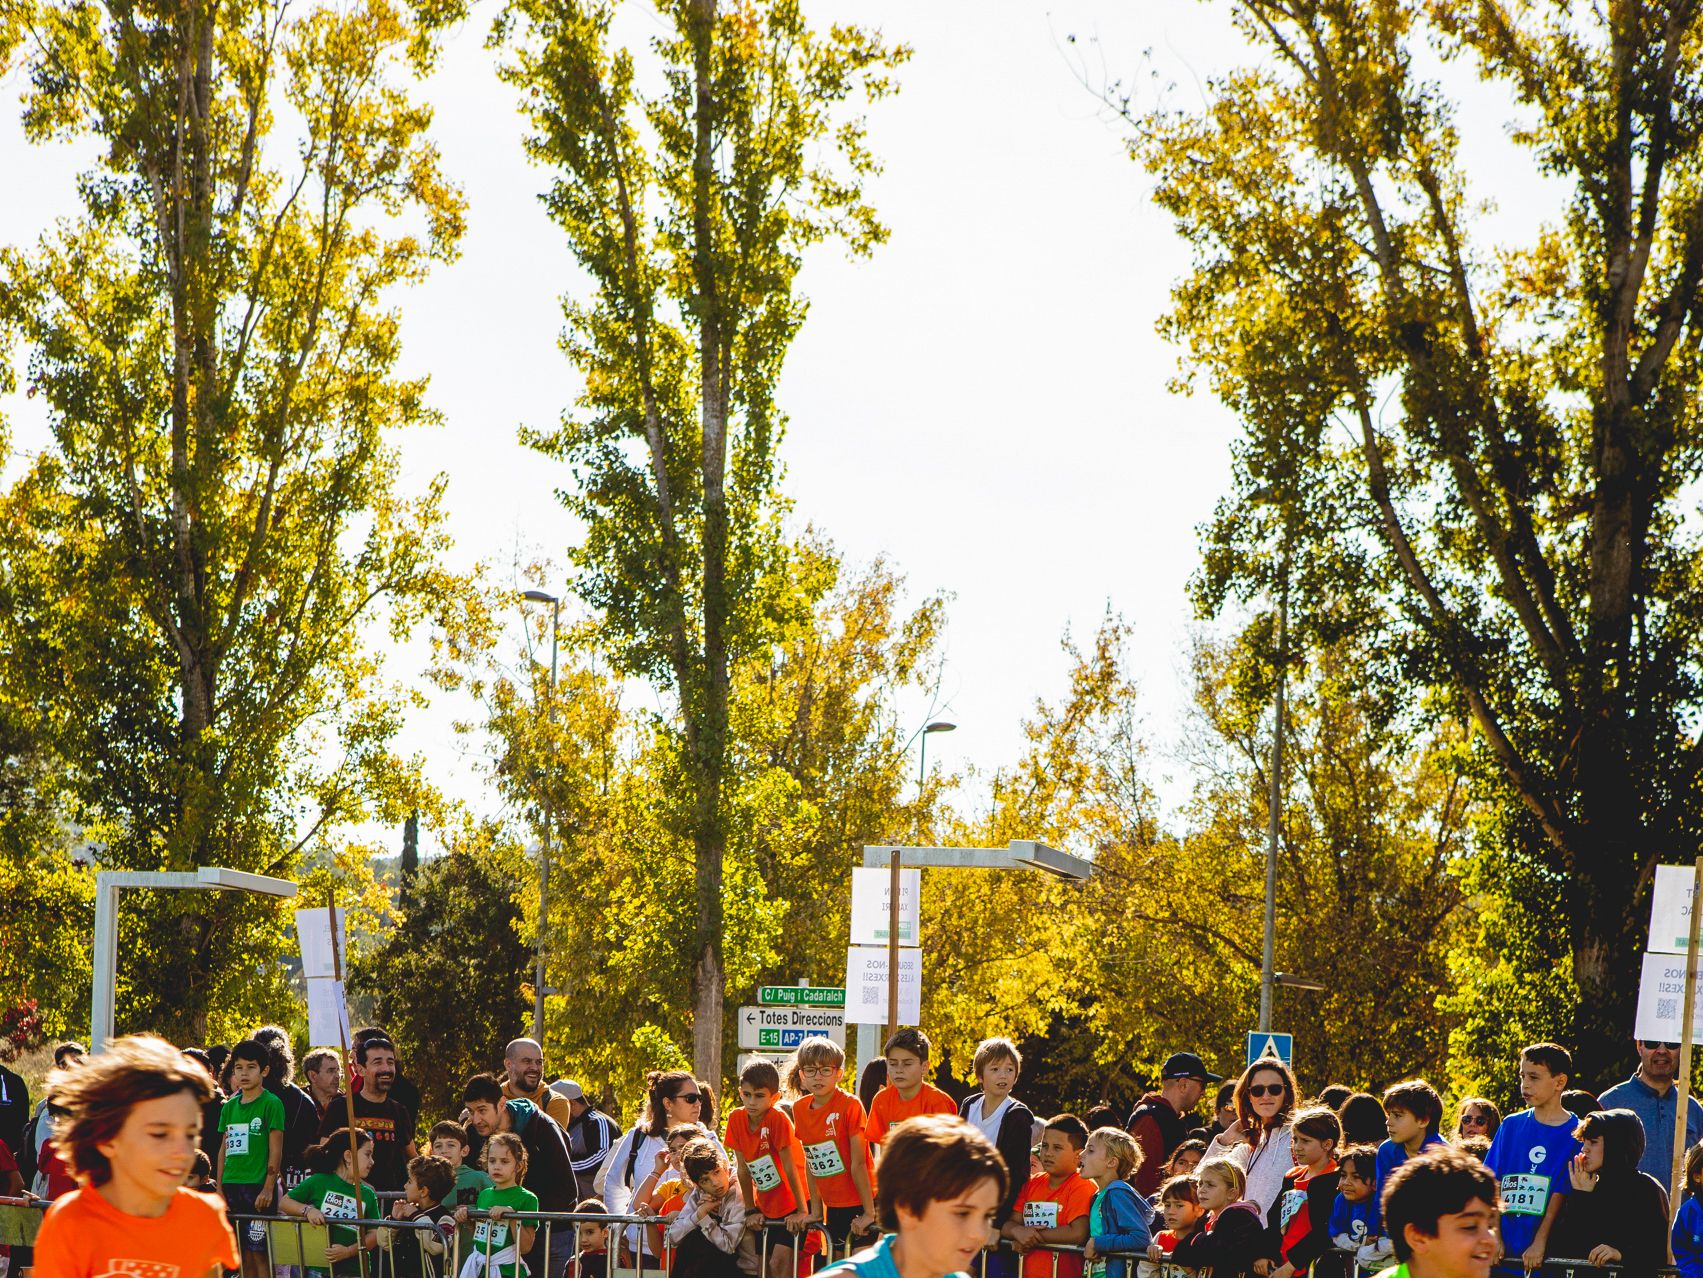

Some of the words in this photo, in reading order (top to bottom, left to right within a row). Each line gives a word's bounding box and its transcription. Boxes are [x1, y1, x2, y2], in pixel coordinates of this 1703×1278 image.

[765, 989, 775, 1000] C/
[778, 989, 795, 1002] Puig
[798, 990, 801, 1001] i
[803, 989, 843, 1001] Cadafalch
[759, 1010, 788, 1025] Totes
[791, 1011, 843, 1027] Direccions
[760, 1032, 778, 1043] E-15
[784, 1032, 803, 1044] AP-7
[227, 1139, 242, 1149] 33
[1504, 1193, 1535, 1205] 4181
[476, 1226, 498, 1238] 256
